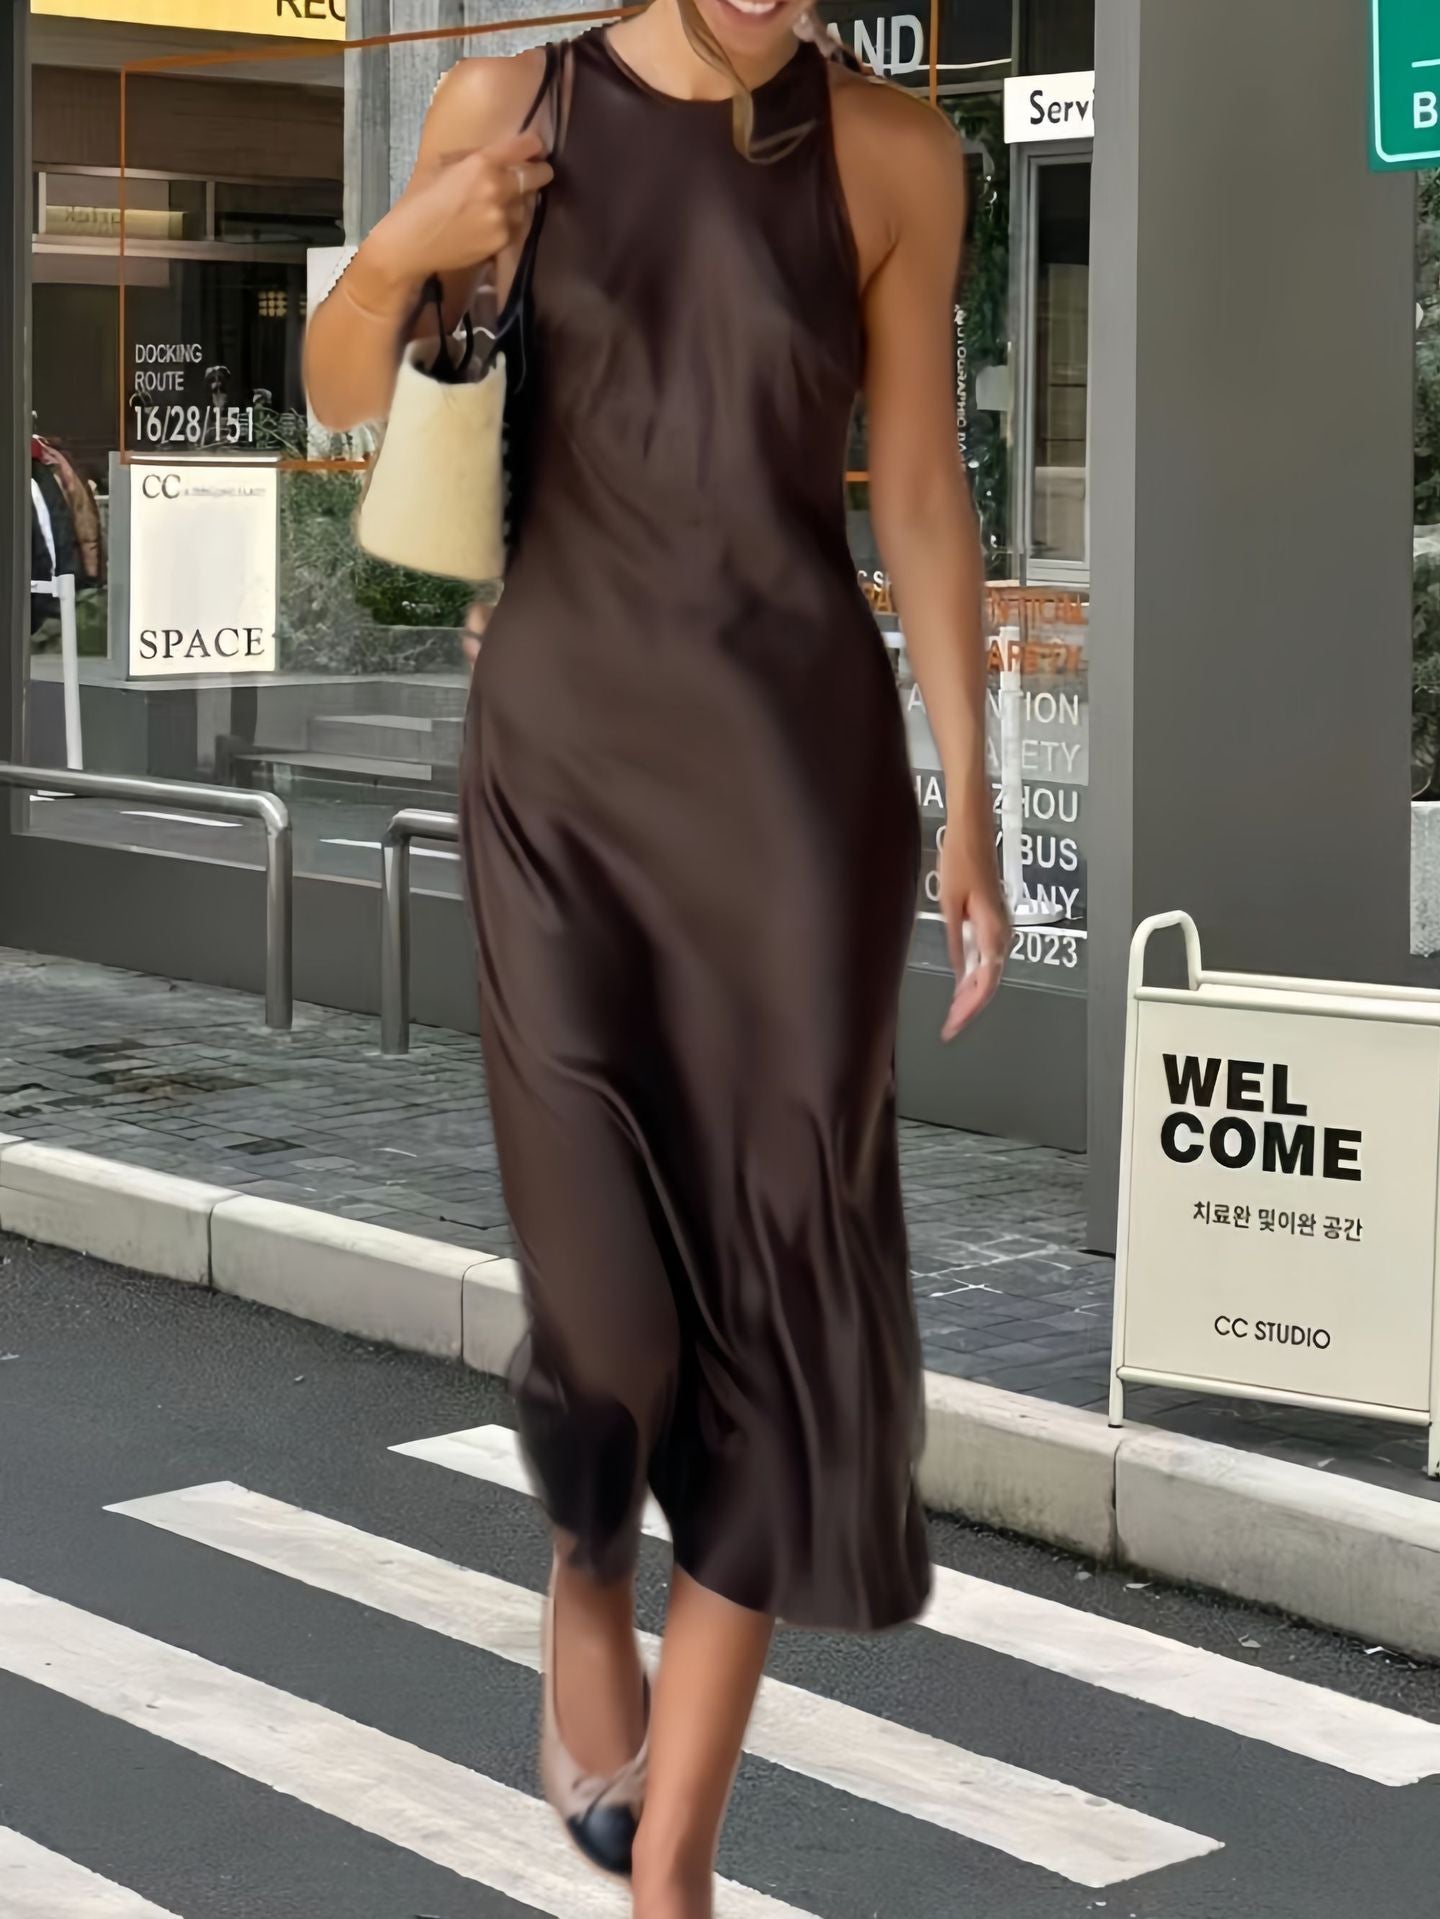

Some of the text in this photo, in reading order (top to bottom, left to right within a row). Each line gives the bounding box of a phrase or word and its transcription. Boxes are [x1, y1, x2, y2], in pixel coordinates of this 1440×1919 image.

[135, 343, 202, 363] DOCKING
[134, 371, 184, 391] ROUTE
[134, 405, 253, 447] 16/28/151
[142, 474, 181, 499] CC
[139, 627, 265, 660] SPACE
[1021, 834, 1078, 872] BUS
[1009, 931, 1078, 968] 2023
[1162, 1053, 1308, 1117] WEL
[1160, 1111, 1363, 1182] COME
[1322, 1217, 1363, 1242] 공간
[1214, 1315, 1331, 1349] CC STUDIO
